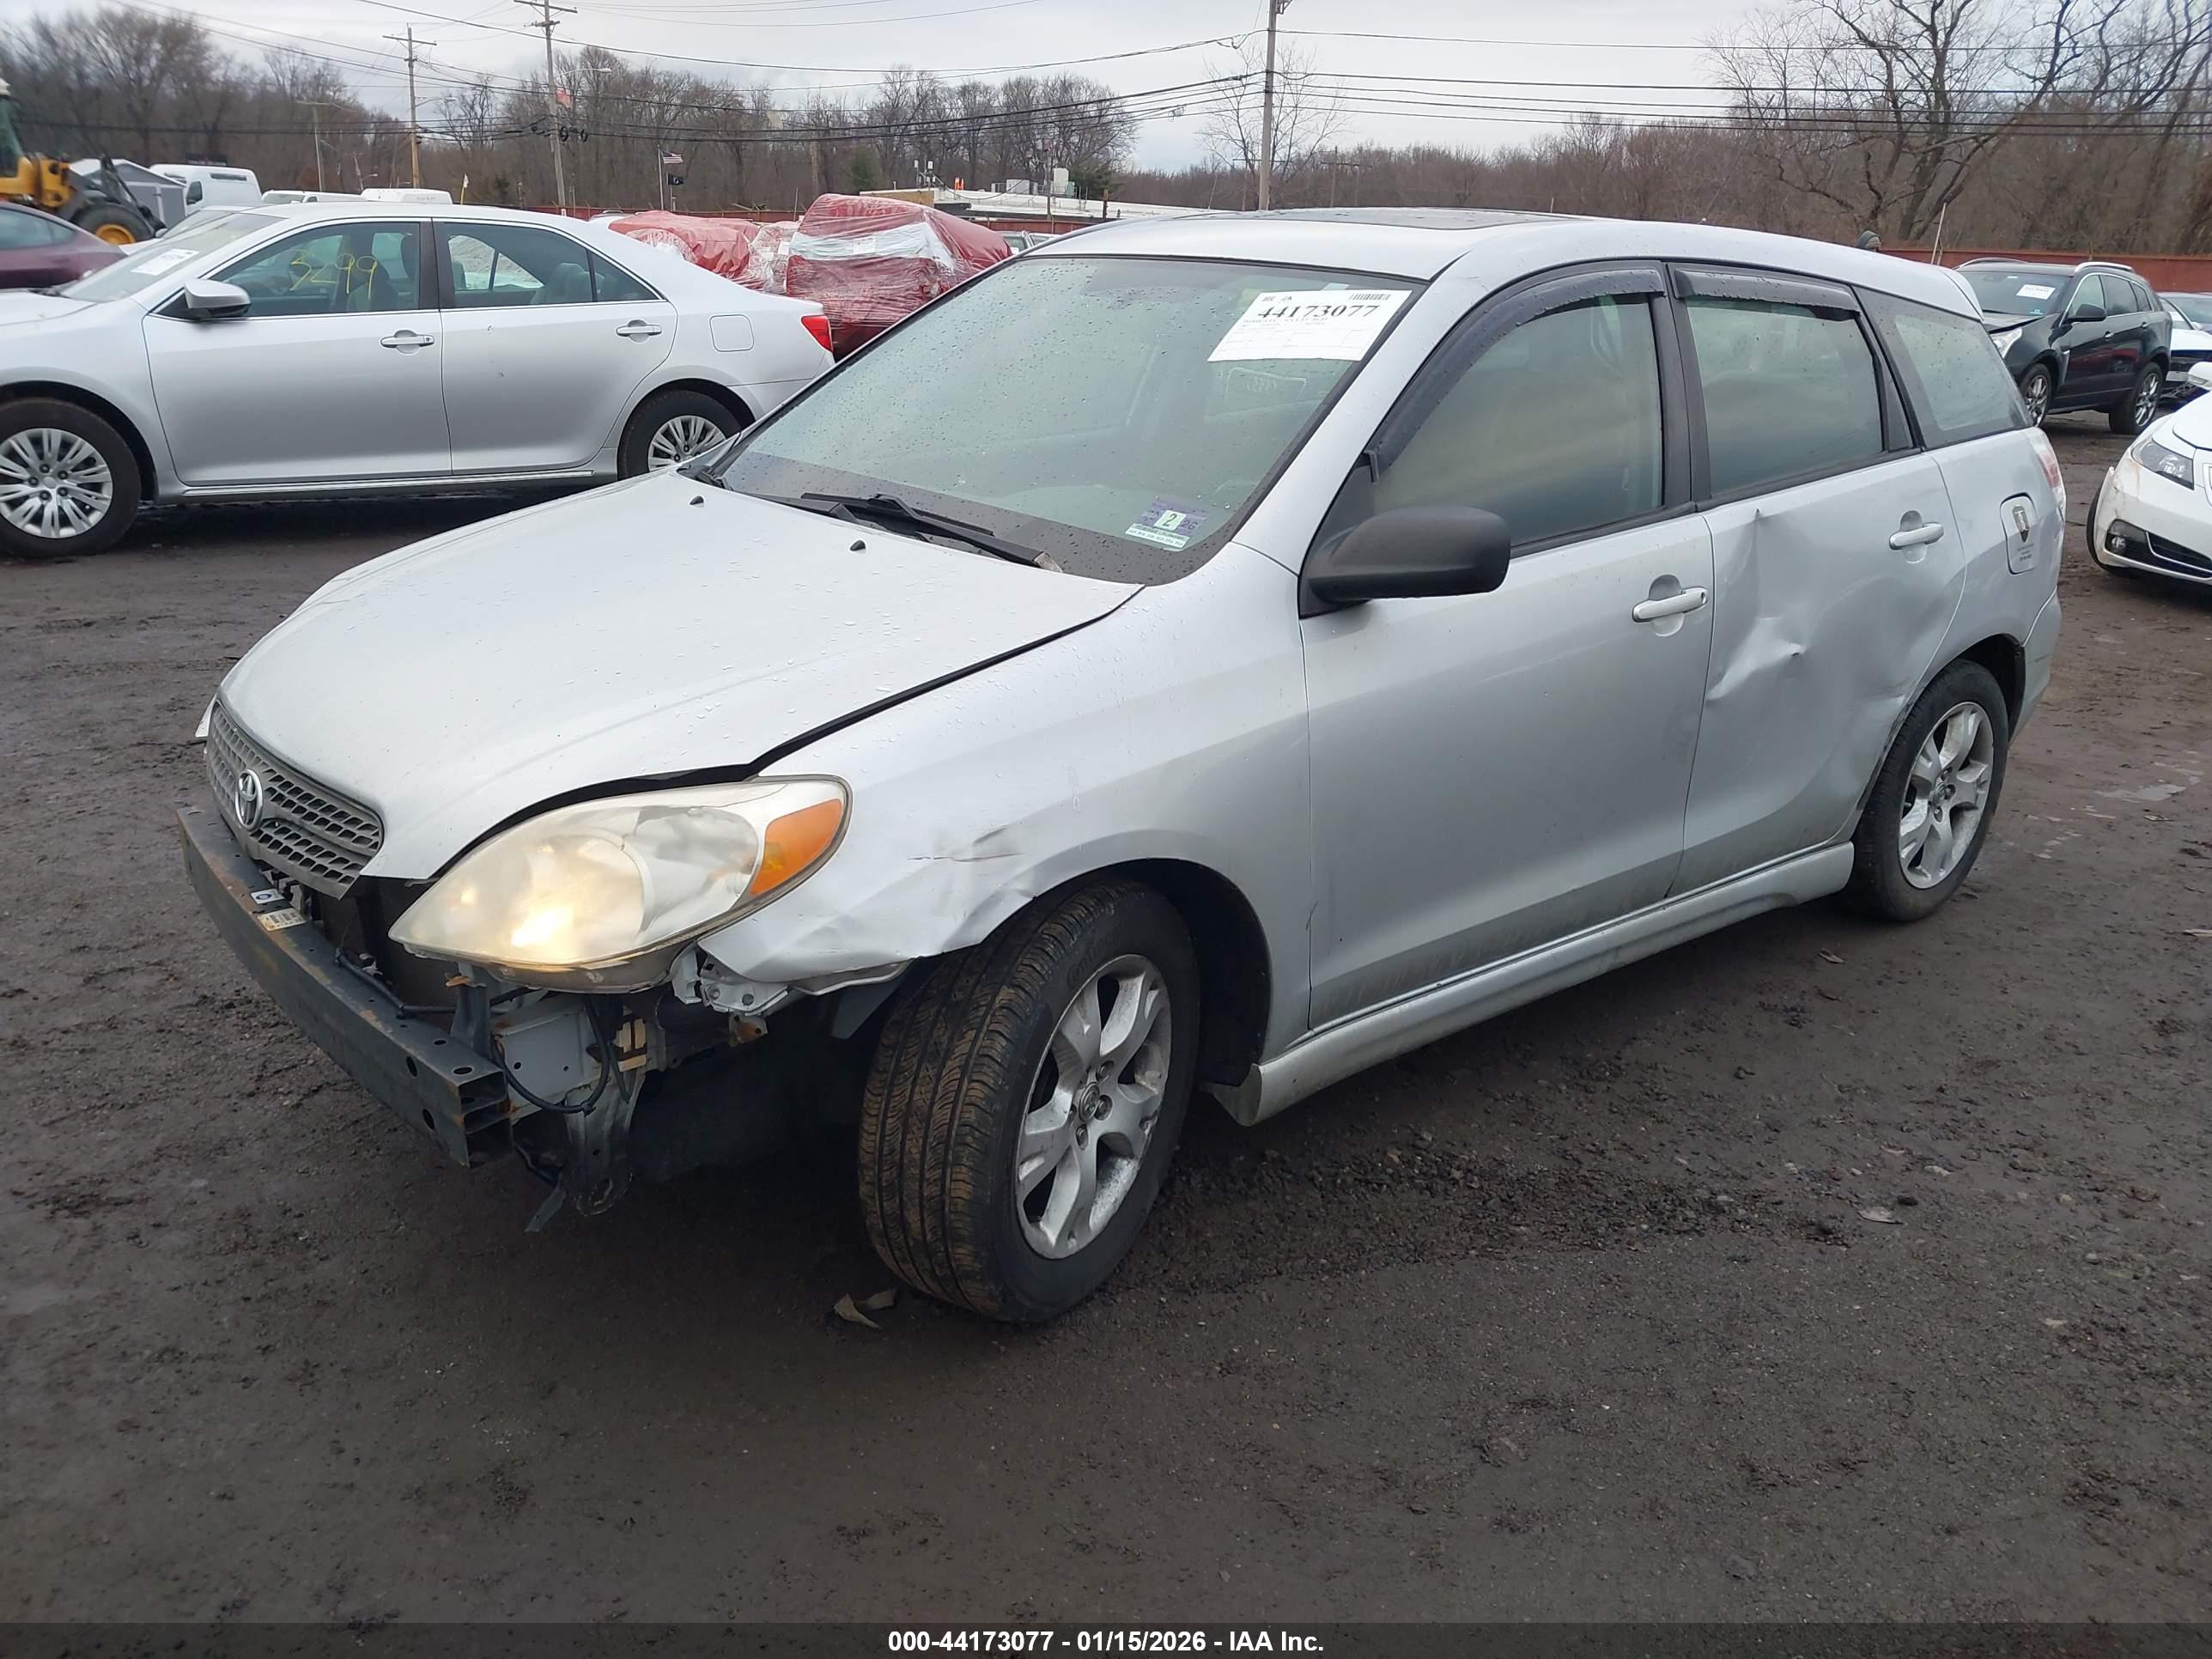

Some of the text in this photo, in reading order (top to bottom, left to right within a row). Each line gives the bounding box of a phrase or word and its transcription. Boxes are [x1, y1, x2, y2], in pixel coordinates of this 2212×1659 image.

[289, 248, 378, 300] 3299
[1257, 304, 1381, 319] 44173077
[1162, 513, 1178, 527] 2
